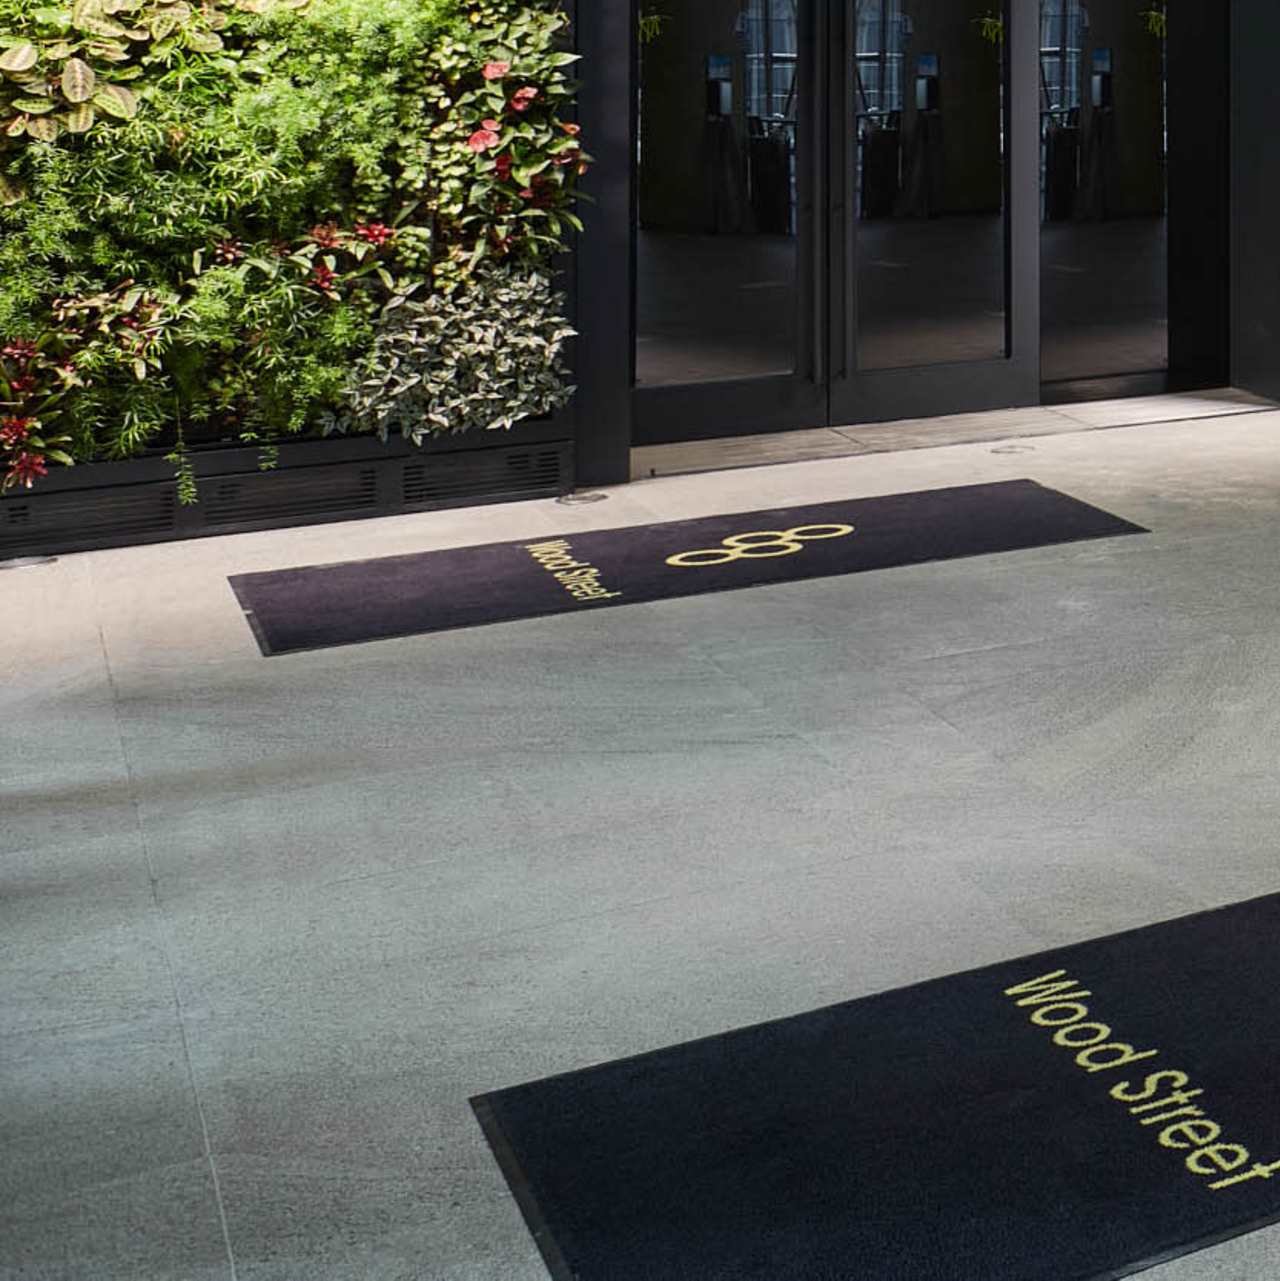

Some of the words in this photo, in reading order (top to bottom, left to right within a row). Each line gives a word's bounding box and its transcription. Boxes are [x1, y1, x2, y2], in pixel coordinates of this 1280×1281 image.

[524, 539, 591, 571] Wood
[553, 567, 622, 601] Street
[1004, 969, 1158, 1073] Wood
